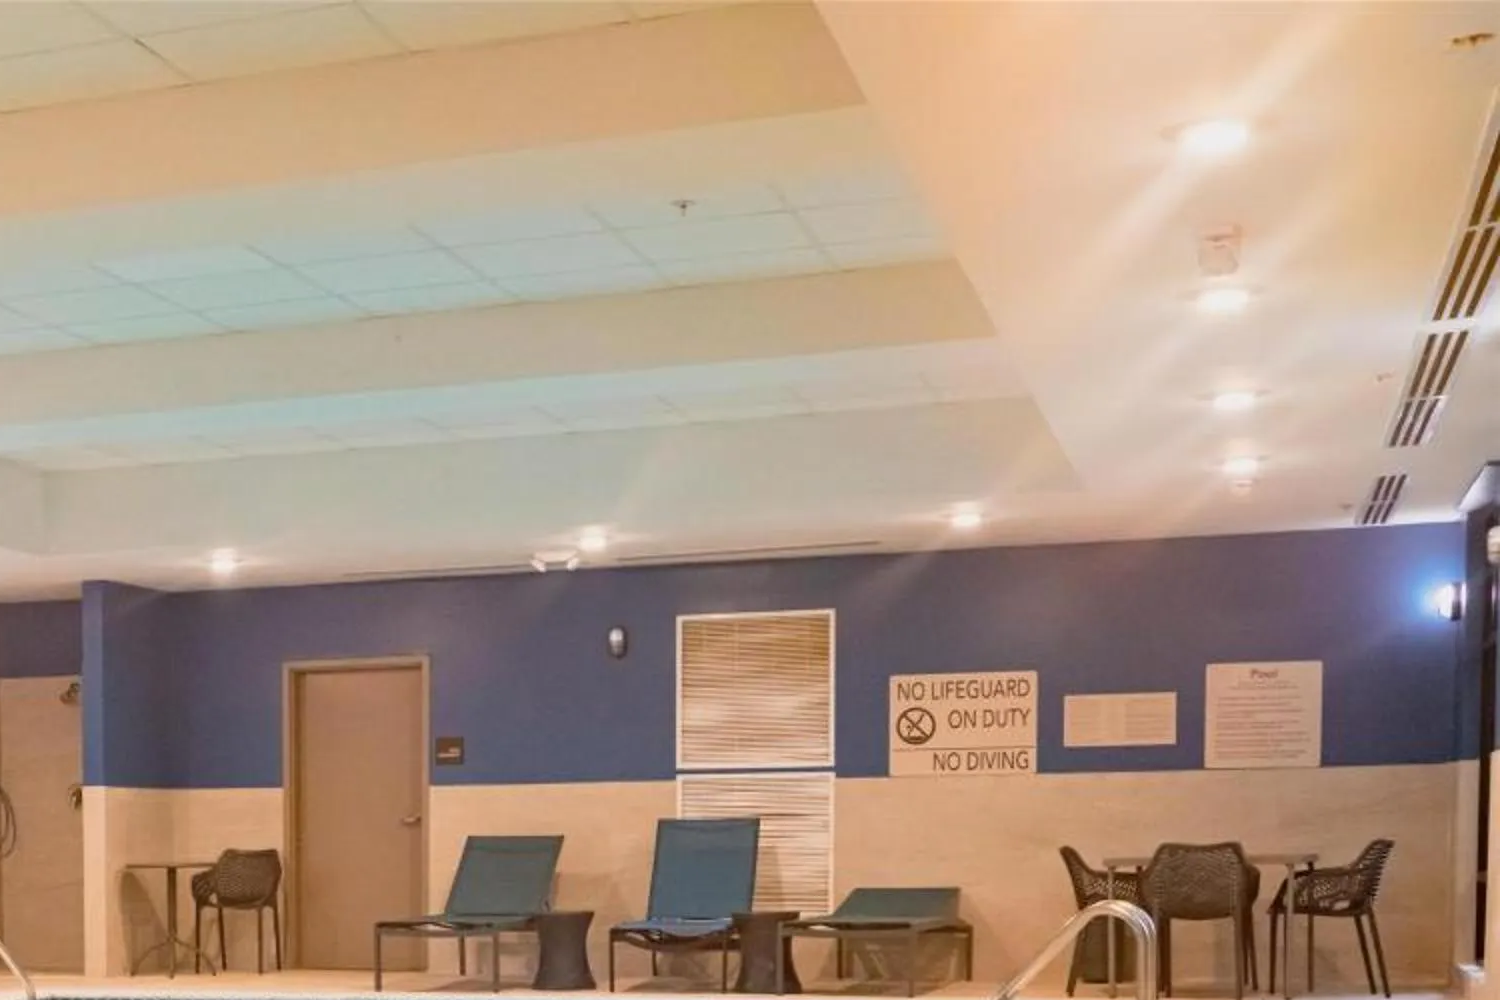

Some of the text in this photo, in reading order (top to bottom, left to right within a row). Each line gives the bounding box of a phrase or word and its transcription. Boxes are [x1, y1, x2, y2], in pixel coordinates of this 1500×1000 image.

[896, 678, 1032, 701] NO LIFEGUARD
[947, 707, 1032, 729] ON DUTY
[932, 750, 1030, 772] NO DIVING
